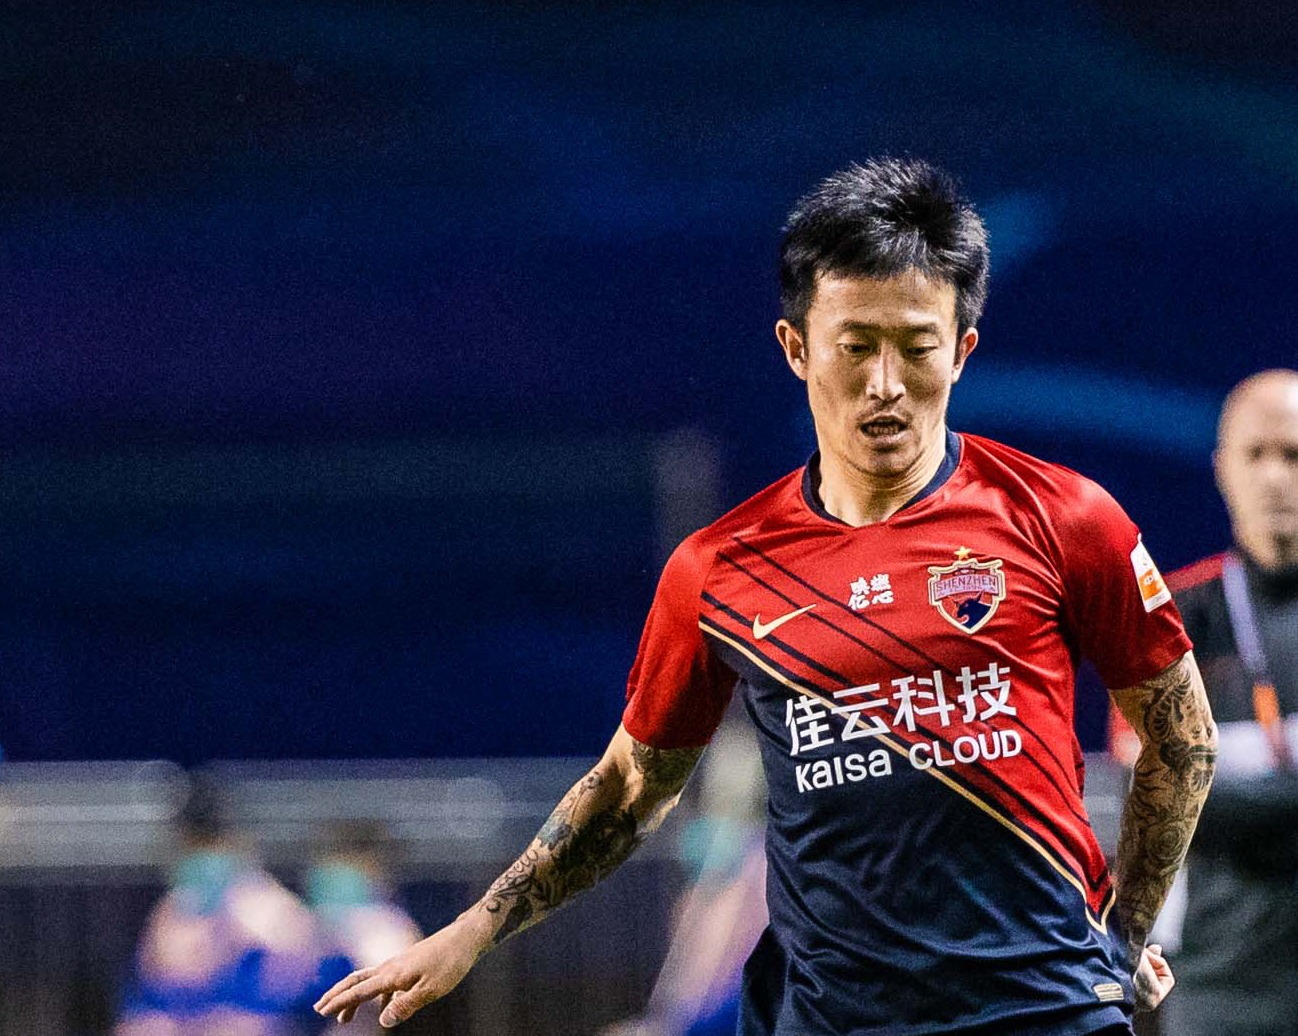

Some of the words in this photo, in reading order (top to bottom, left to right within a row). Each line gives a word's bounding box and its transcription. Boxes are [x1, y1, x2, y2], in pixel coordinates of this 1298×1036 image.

[936, 575, 996, 591] SHENZHEN
[785, 662, 1017, 757] 佳云科技
[908, 729, 1022, 770] CLOUD
